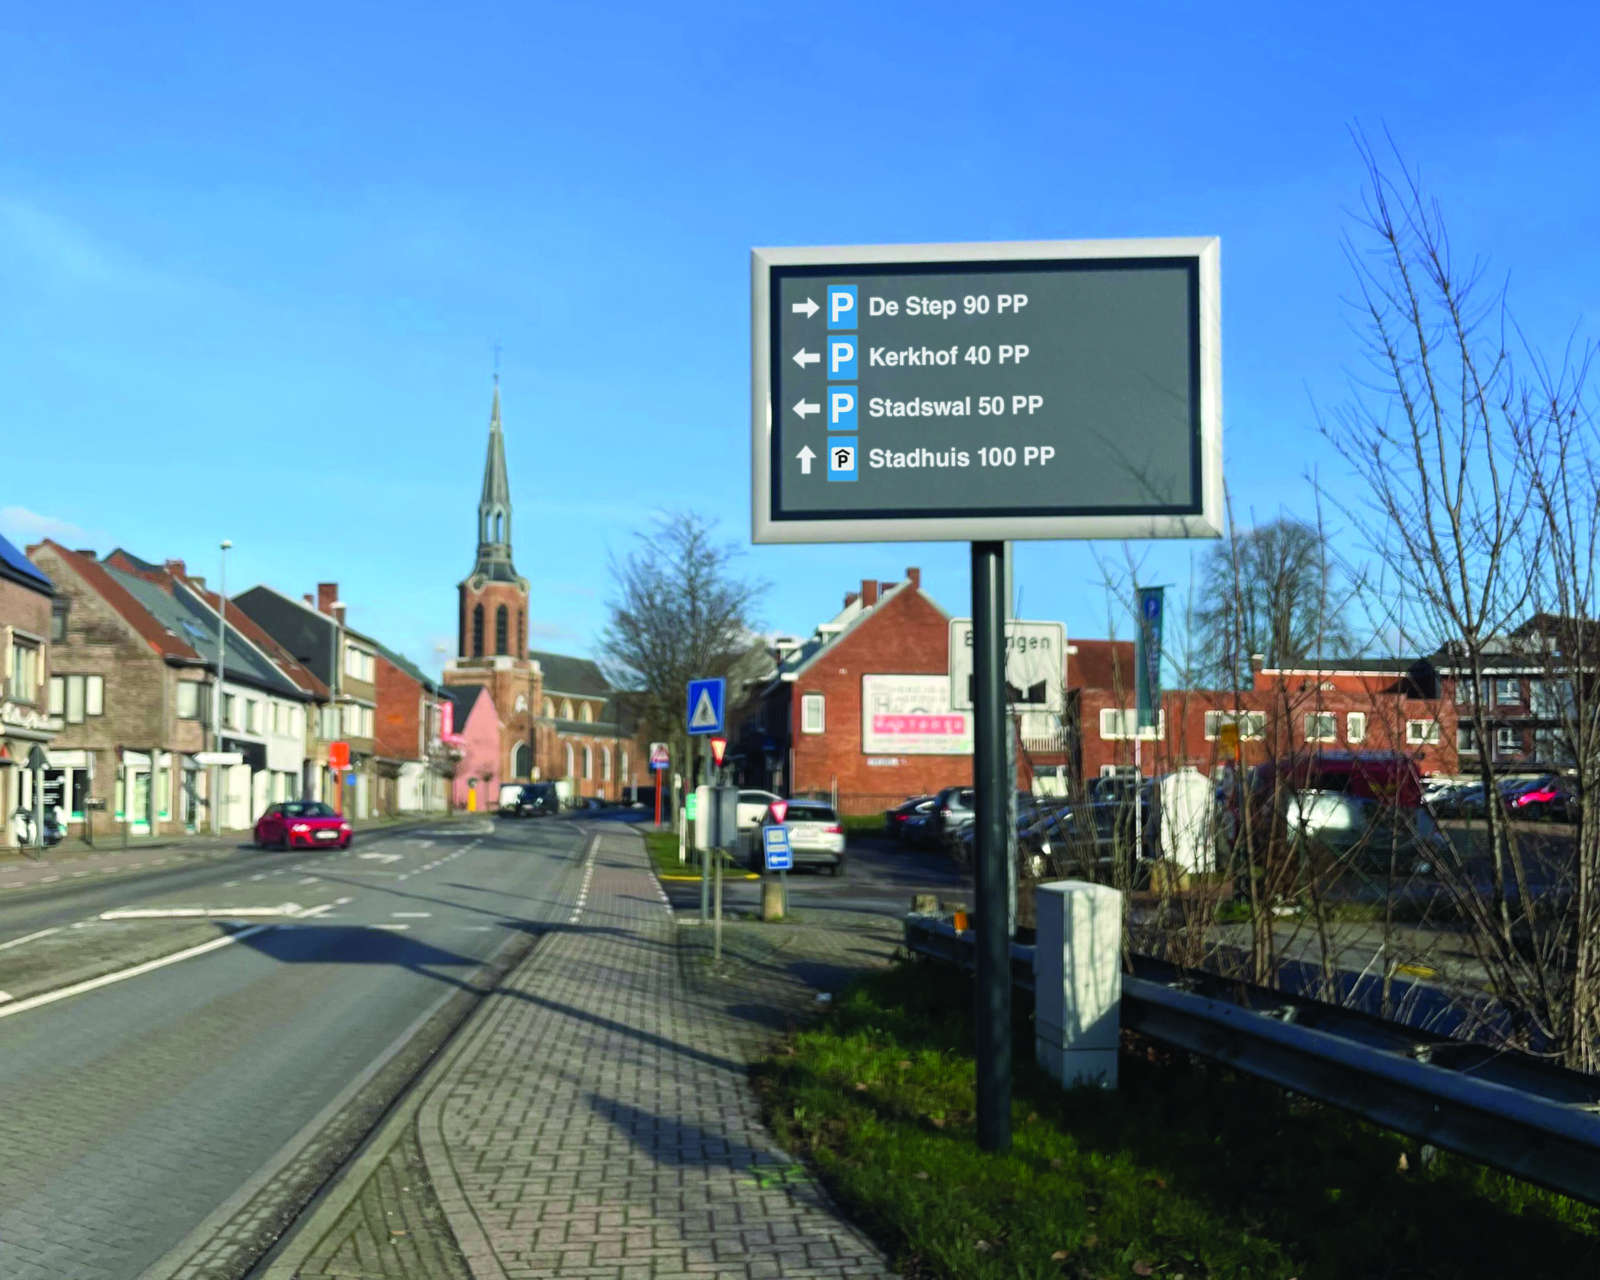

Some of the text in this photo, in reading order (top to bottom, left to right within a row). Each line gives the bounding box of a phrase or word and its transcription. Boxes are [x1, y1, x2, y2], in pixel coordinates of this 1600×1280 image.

[831, 292, 1029, 322] P De Step 90 PP
[831, 342, 1030, 373] P Kerkhof 40 PP
[831, 393, 1044, 423] P Stadswal 50 PP
[869, 447, 970, 469] Stadhuis
[977, 446, 1017, 467] 100
[1024, 446, 1055, 466] PP
